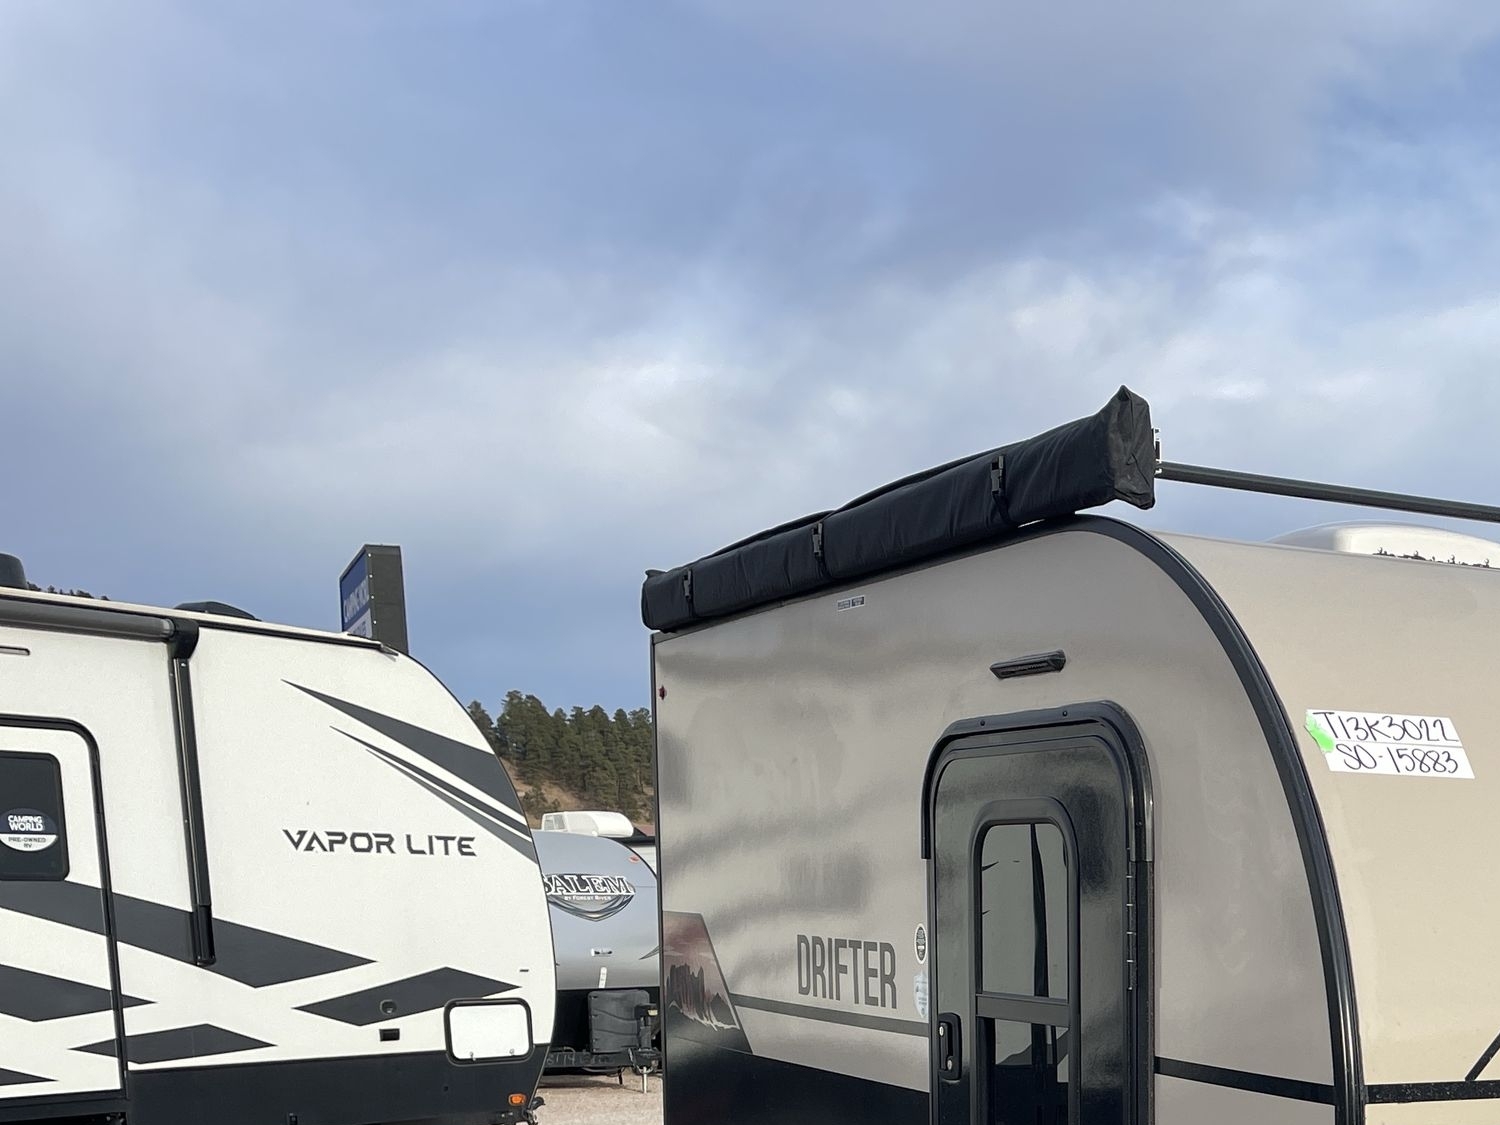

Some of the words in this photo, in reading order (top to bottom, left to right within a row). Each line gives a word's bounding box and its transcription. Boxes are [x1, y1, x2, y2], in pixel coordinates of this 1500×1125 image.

[8, 814, 43, 823] CAMPING
[9, 822, 43, 831] WORLD
[282, 829, 397, 854] VAPOR
[405, 833, 477, 857] LITE
[797, 934, 897, 1009] DRIFTER
